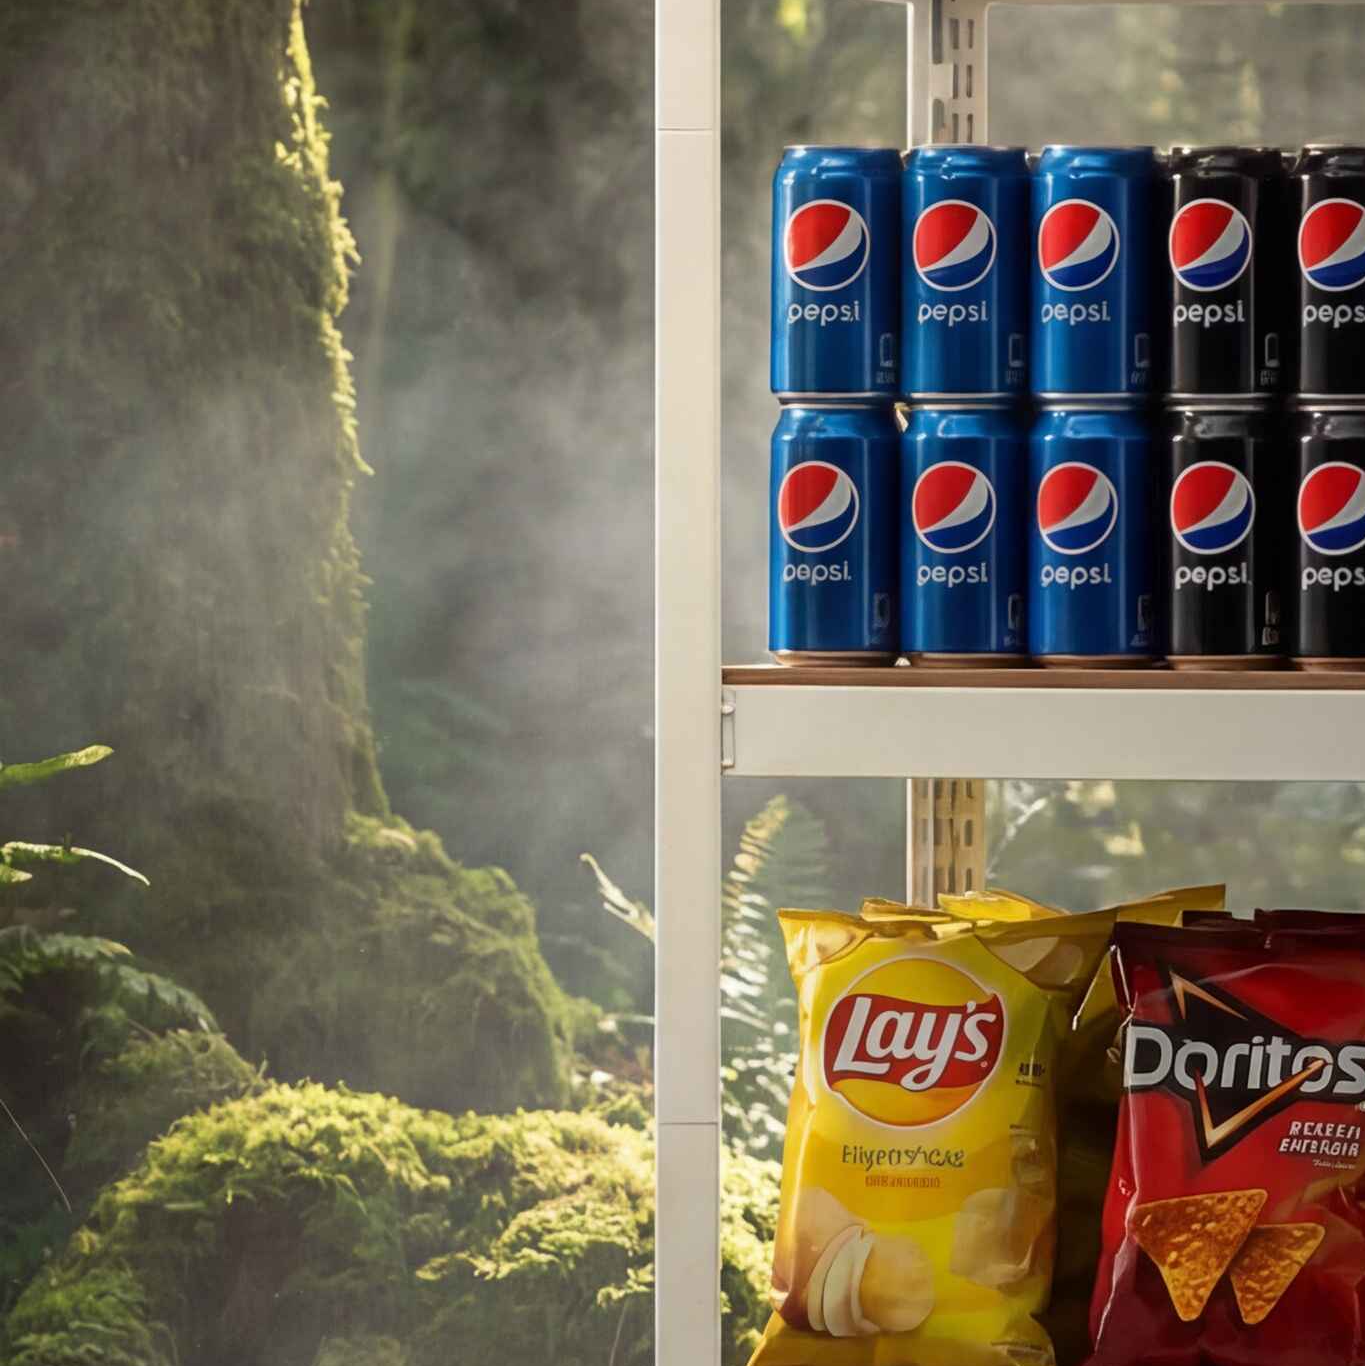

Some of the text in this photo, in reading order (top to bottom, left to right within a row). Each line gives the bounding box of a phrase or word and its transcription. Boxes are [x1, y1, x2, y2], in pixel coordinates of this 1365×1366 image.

[788, 299, 860, 327] pepsi
[918, 299, 988, 327] pepsi
[1041, 299, 1111, 327] pepsi
[1173, 299, 1245, 328] pepsi
[783, 560, 851, 586] pepsi
[917, 560, 988, 589] pepsi
[1041, 560, 1111, 589] pepsi
[1174, 560, 1251, 590] pepsi
[832, 996, 997, 1092] Lay's
